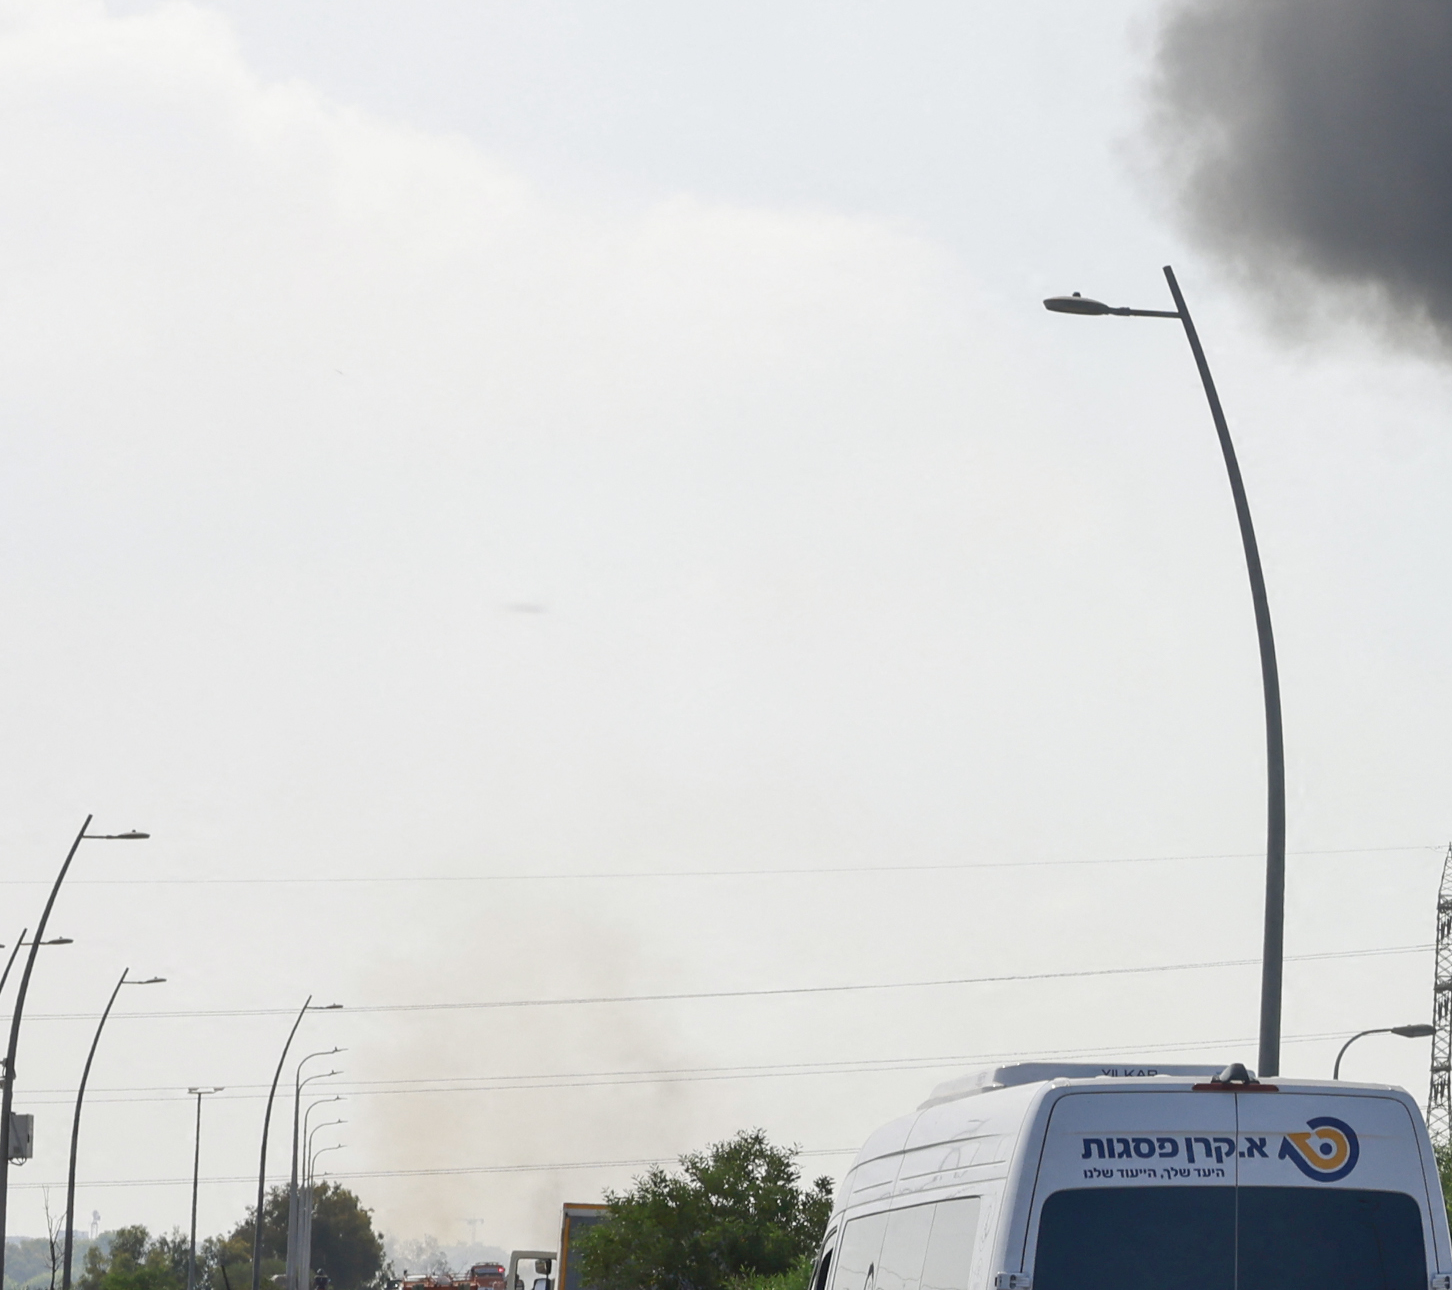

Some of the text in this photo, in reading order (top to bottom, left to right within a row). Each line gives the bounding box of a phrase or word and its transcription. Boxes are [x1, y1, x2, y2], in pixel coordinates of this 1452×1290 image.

[1081, 1137, 1179, 1159] פסגות
[1083, 1167, 1113, 1179] שלנו
[1116, 1168, 1156, 1179] הייעוד
[1193, 1168, 1225, 1179] היעד
